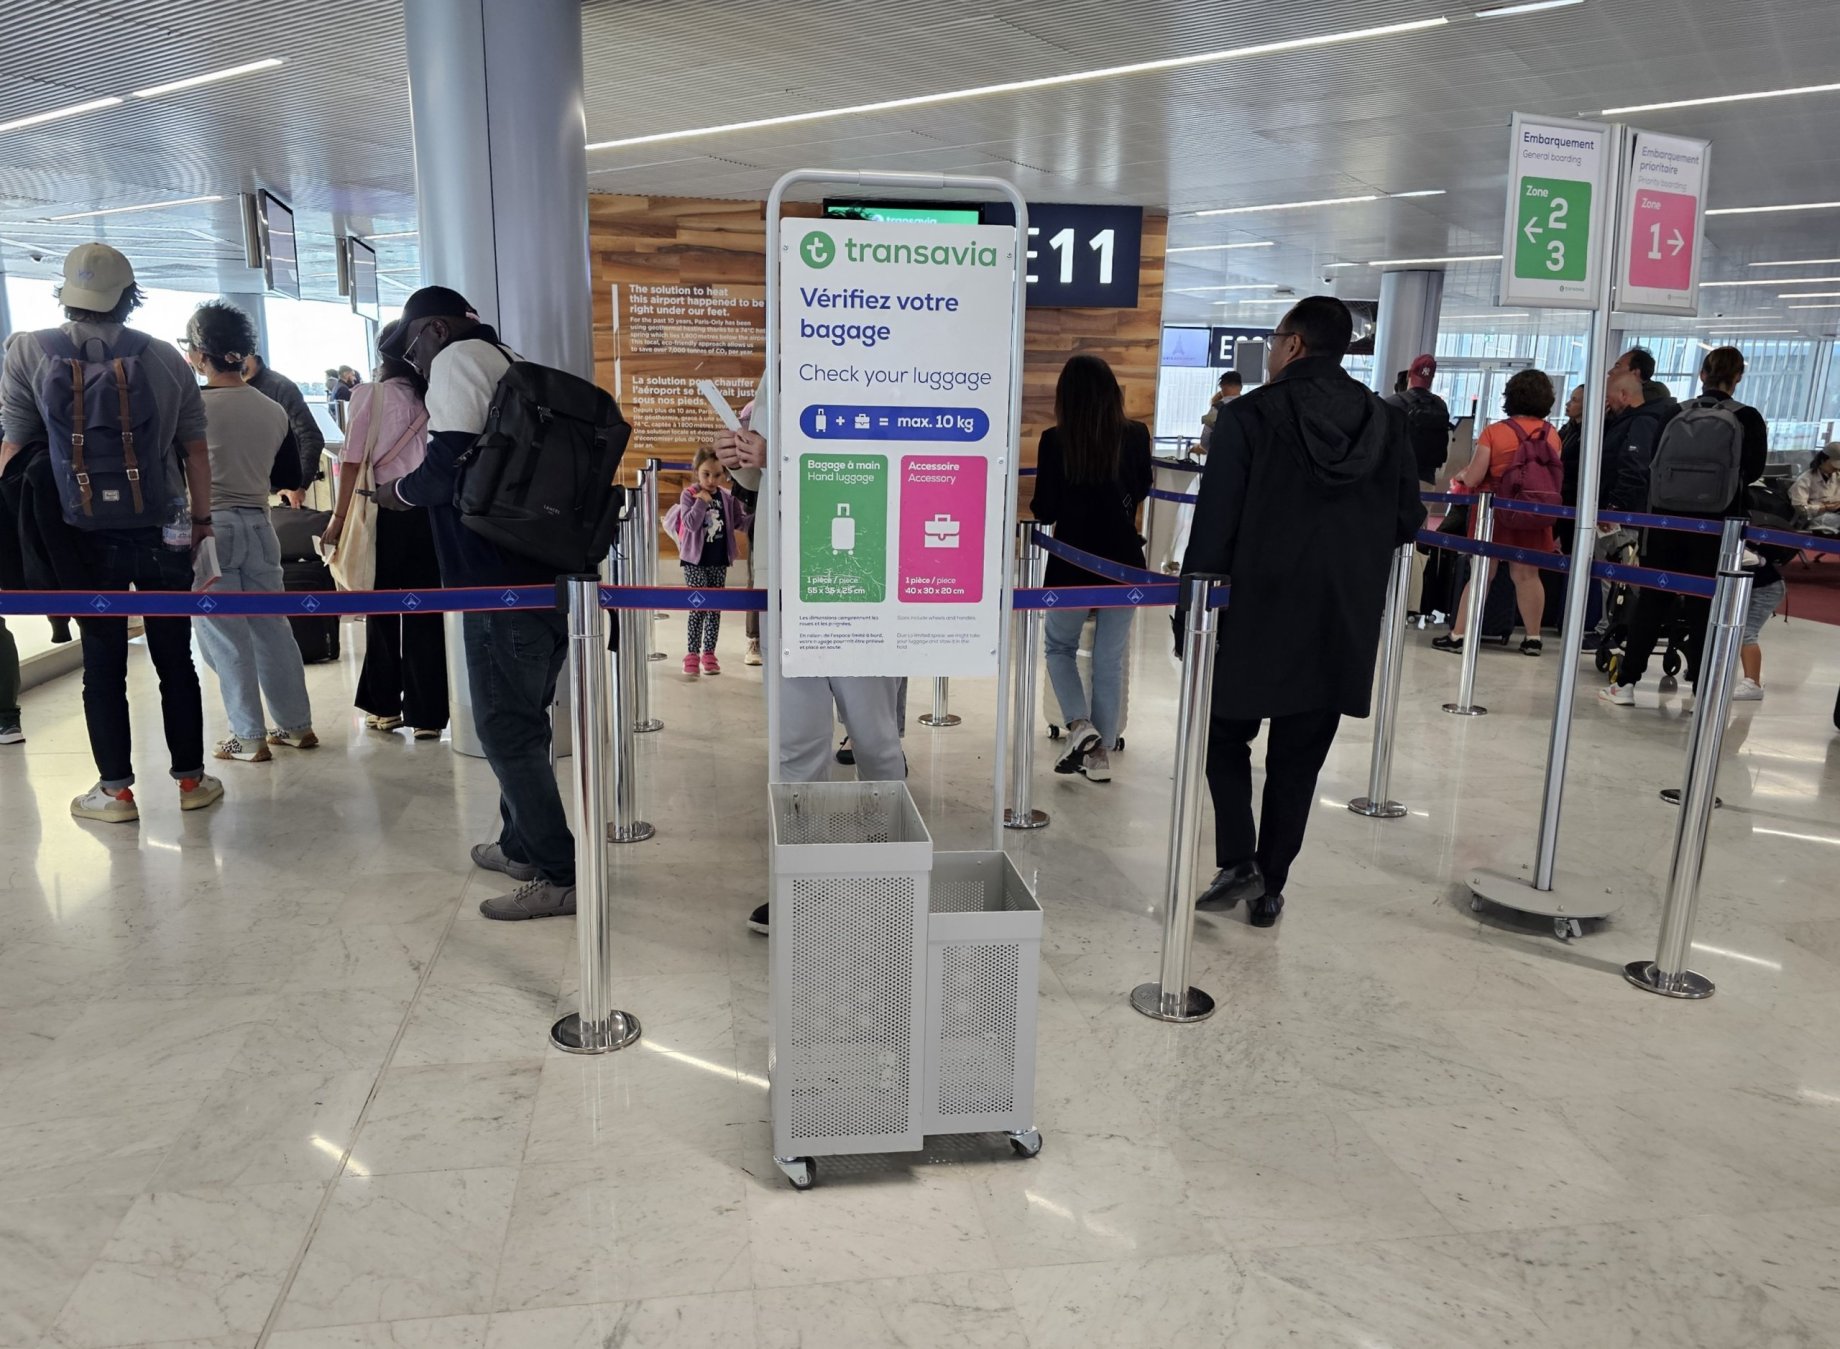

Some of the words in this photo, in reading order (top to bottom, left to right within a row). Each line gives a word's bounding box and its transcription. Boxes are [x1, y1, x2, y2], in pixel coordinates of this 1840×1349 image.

[1524, 131, 1594, 150] Embarquement
[1523, 149, 1550, 160] General
[1551, 152, 1582, 166] boarding
[1642, 146, 1699, 165] Embarquement
[1526, 185, 1548, 198] Zone
[1642, 198, 1661, 210] Zone
[1548, 197, 1568, 230] 2
[1648, 222, 1662, 260] 1
[844, 238, 997, 267] transavia
[1546, 240, 1564, 272] 3
[629, 284, 648, 294] The
[650, 285, 690, 295] solution
[694, 286, 704, 296] to
[706, 286, 728, 296] heat
[630, 294, 648, 304] this
[650, 295, 684, 306] airport
[687, 296, 736, 307] happened
[739, 298, 750, 307] to
[752, 298, 764, 308] be
[800, 287, 891, 310] Vérifiez
[896, 293, 959, 312] votre
[630, 304, 654, 315] right
[656, 306, 686, 314] under
[708, 306, 730, 316] feet.
[800, 318, 891, 347] bagage
[632, 376, 644, 384] La
[646, 376, 686, 386] solution
[714, 378, 754, 387] chauffer
[800, 363, 860, 382] Check
[864, 369, 908, 387] your
[914, 366, 992, 391] luggage
[737, 388, 756, 398] just
[678, 396, 707, 406] pieds.
[897, 416, 933, 428] max.
[936, 415, 954, 428] 10
[956, 416, 974, 433] kg
[808, 460, 846, 472] Bagage
[856, 460, 880, 470] main
[908, 461, 960, 470] Accessoire
[808, 472, 834, 480] Hand
[836, 472, 874, 484] luggage
[908, 473, 956, 485] Accessory
[808, 576, 811, 584] 1
[910, 576, 930, 585] pièce
[936, 576, 956, 585] piece
